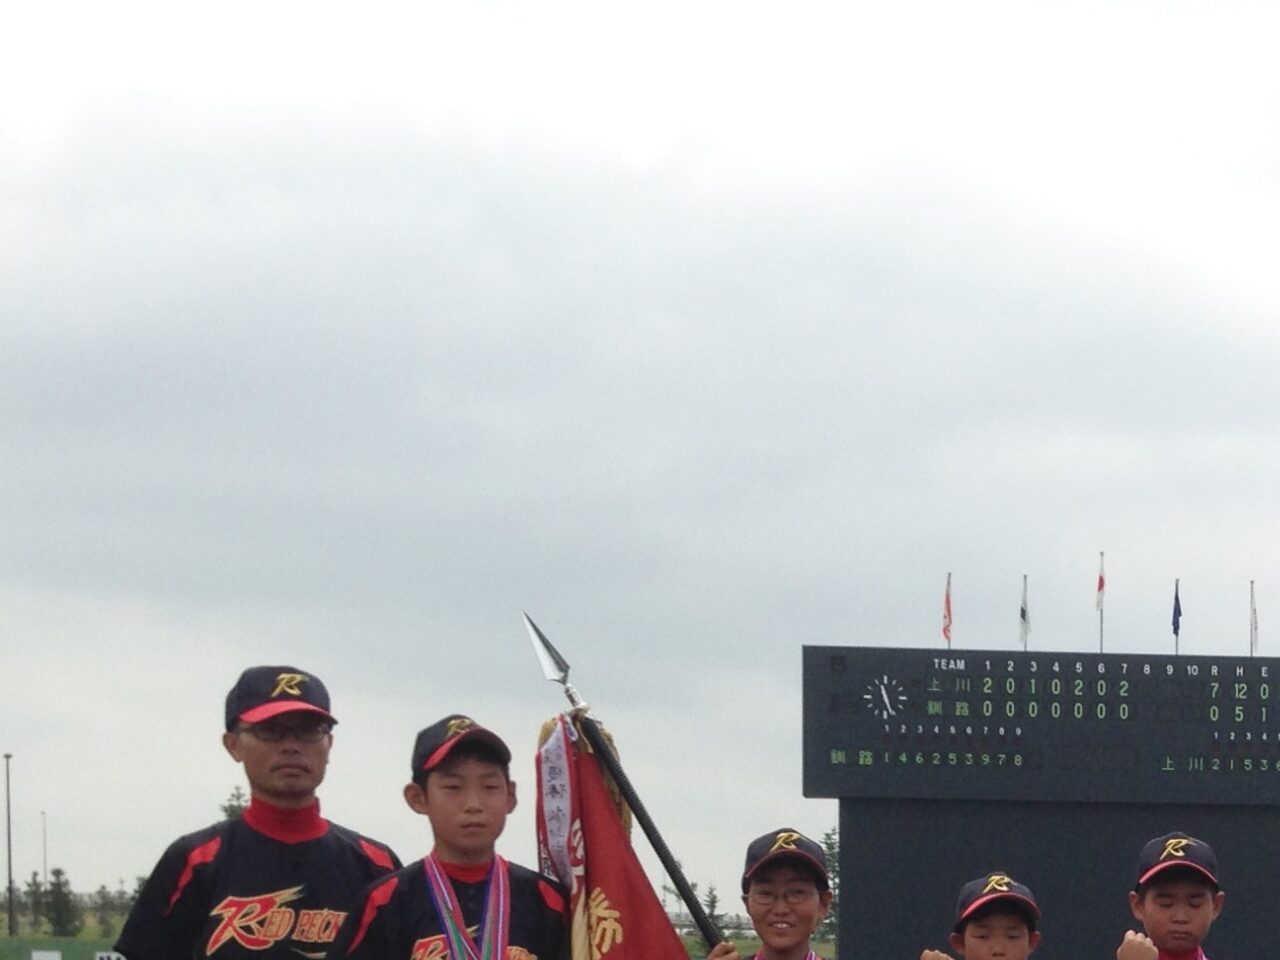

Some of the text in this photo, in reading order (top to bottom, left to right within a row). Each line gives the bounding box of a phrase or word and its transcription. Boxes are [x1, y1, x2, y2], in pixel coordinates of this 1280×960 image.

[933, 658, 965, 670] TEAM
[1007, 660, 1015, 672] 2
[1030, 660, 1038, 672] 3
[1052, 661, 1060, 672] 4
[1075, 661, 1083, 673] 5
[1097, 662, 1106, 674] 6
[1121, 663, 1128, 674] 7
[1143, 663, 1151, 675] 8
[1166, 664, 1174, 675] 9
[1186, 664, 1199, 676] 10
[1211, 665, 1219, 676] R
[1236, 666, 1244, 677] H
[1261, 666, 1269, 678] E
[983, 677, 993, 694] 2
[1006, 677, 1015, 694] 0
[1051, 678, 1061, 695] 0
[1074, 679, 1084, 696] 2
[1097, 679, 1106, 696] 0
[1119, 680, 1129, 697] 2
[1210, 682, 1220, 698] 7
[1234, 683, 1248, 700] 12
[1260, 683, 1269, 700] 0
[982, 700, 993, 717] 0
[1005, 701, 1015, 717] 0
[1028, 701, 1038, 718] 0
[1051, 702, 1061, 718] 0
[1074, 702, 1083, 719] 0
[1096, 702, 1106, 719] 0
[1119, 703, 1129, 720] 0
[1209, 705, 1219, 722] 0
[1235, 706, 1244, 722] 5
